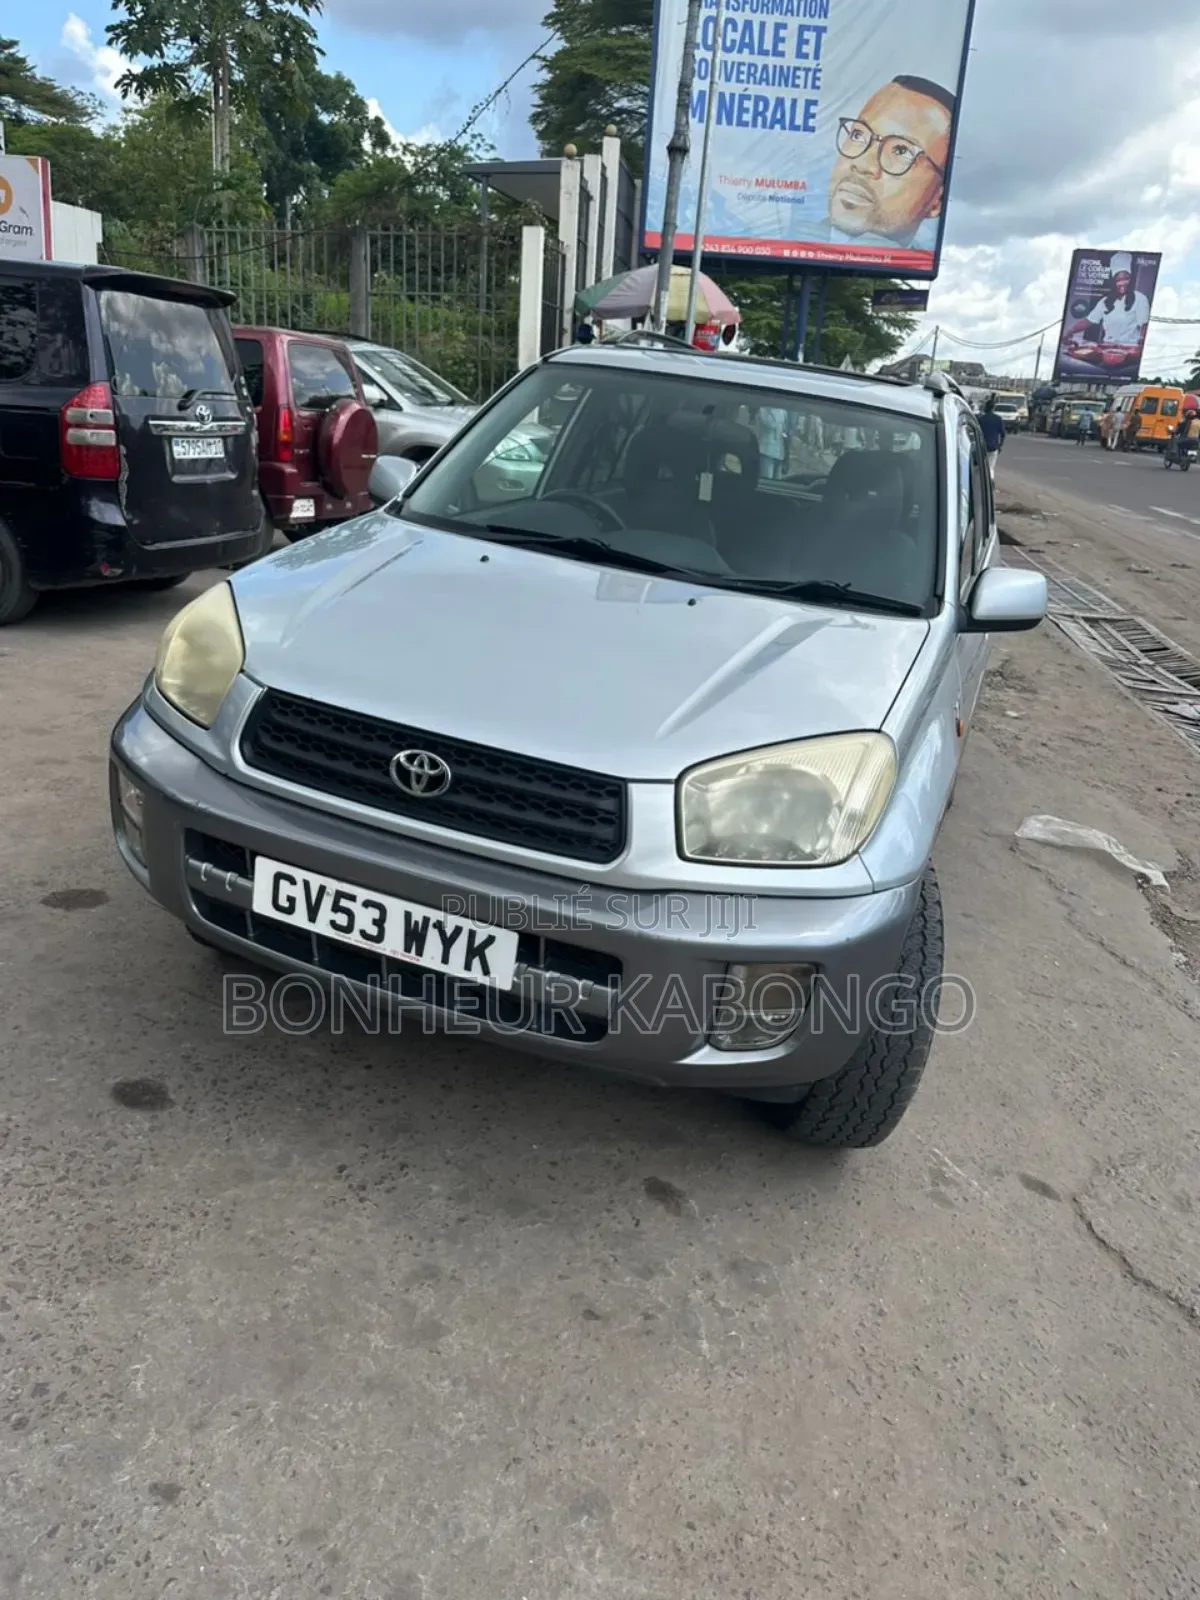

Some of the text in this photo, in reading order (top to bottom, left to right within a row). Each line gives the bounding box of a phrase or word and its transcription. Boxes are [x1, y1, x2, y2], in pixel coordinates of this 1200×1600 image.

[795, 24, 828, 60] ET
[689, 88, 819, 133] MNÉRALE
[754, 177, 807, 191] MULUMBA
[272, 870, 388, 945] GV53
[403, 910, 496, 977] WYK
